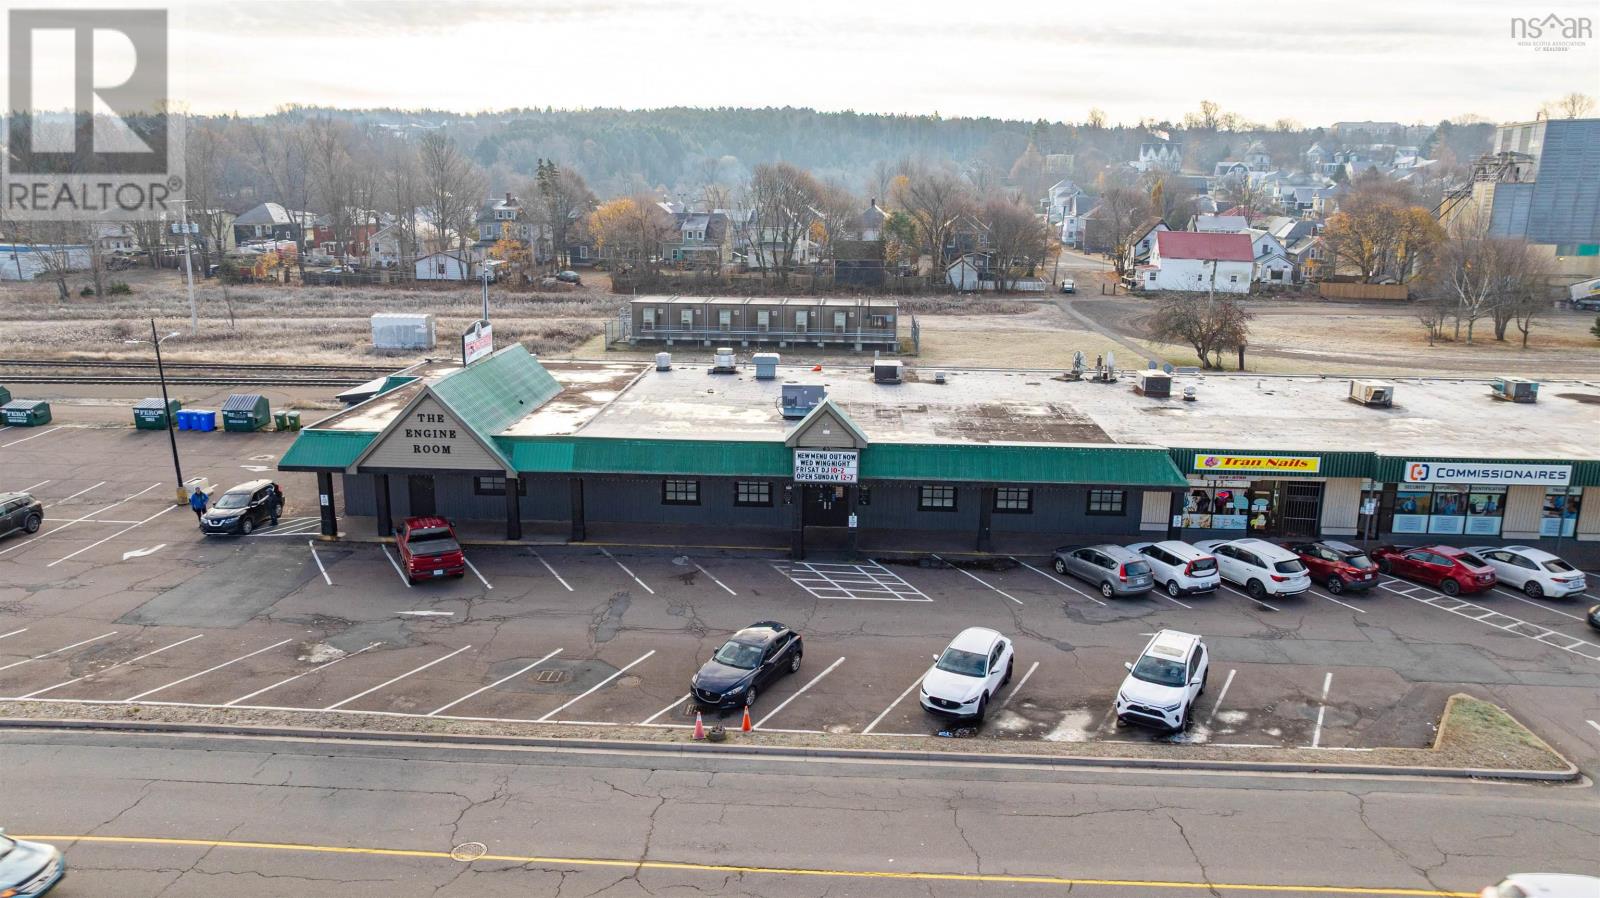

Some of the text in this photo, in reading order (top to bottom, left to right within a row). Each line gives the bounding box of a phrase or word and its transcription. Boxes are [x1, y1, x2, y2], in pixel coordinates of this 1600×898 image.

[417, 413, 445, 423] THE
[405, 429, 457, 439] ENGINE
[413, 444, 451, 454] ROOM
[1224, 457, 1262, 466] Tran
[1266, 458, 1308, 467] Nails
